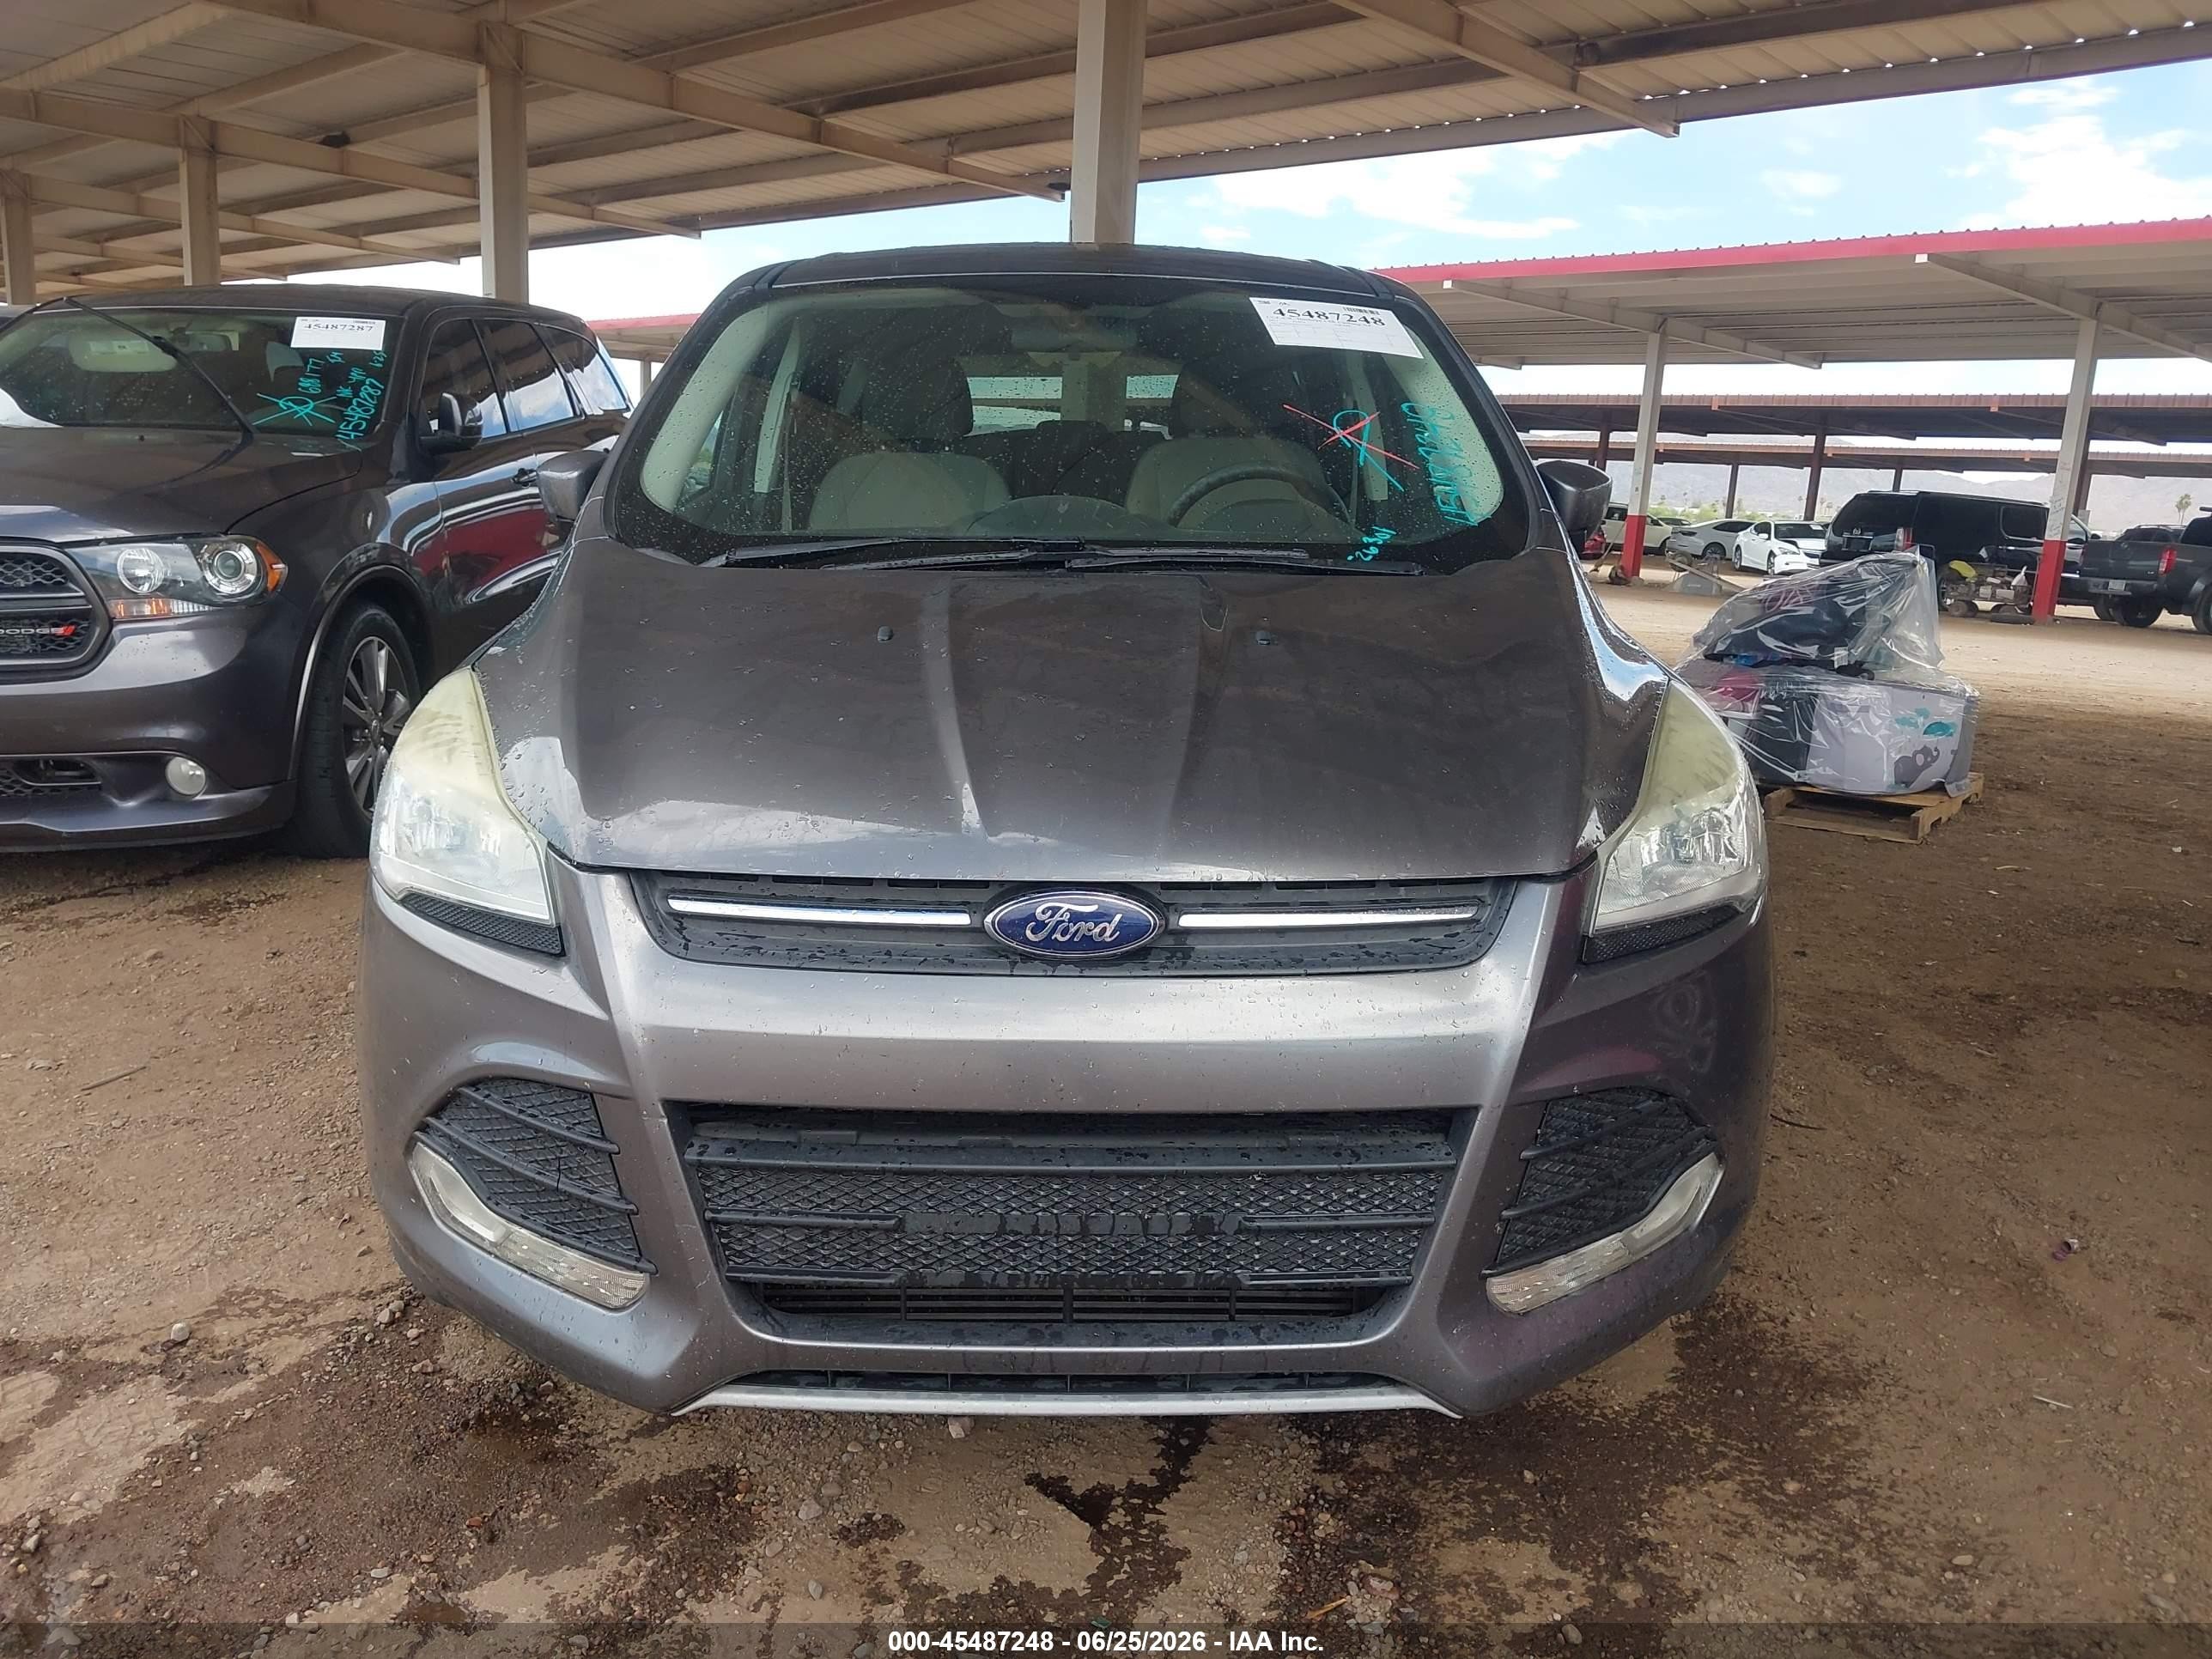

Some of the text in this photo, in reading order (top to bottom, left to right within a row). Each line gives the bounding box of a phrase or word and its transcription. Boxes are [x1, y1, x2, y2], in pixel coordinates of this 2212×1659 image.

[306, 323, 374, 331] 45487287
[1273, 308, 1386, 326] 45487248
[335, 378, 385, 440] 45487287
[1025, 902, 1123, 942] Ford
